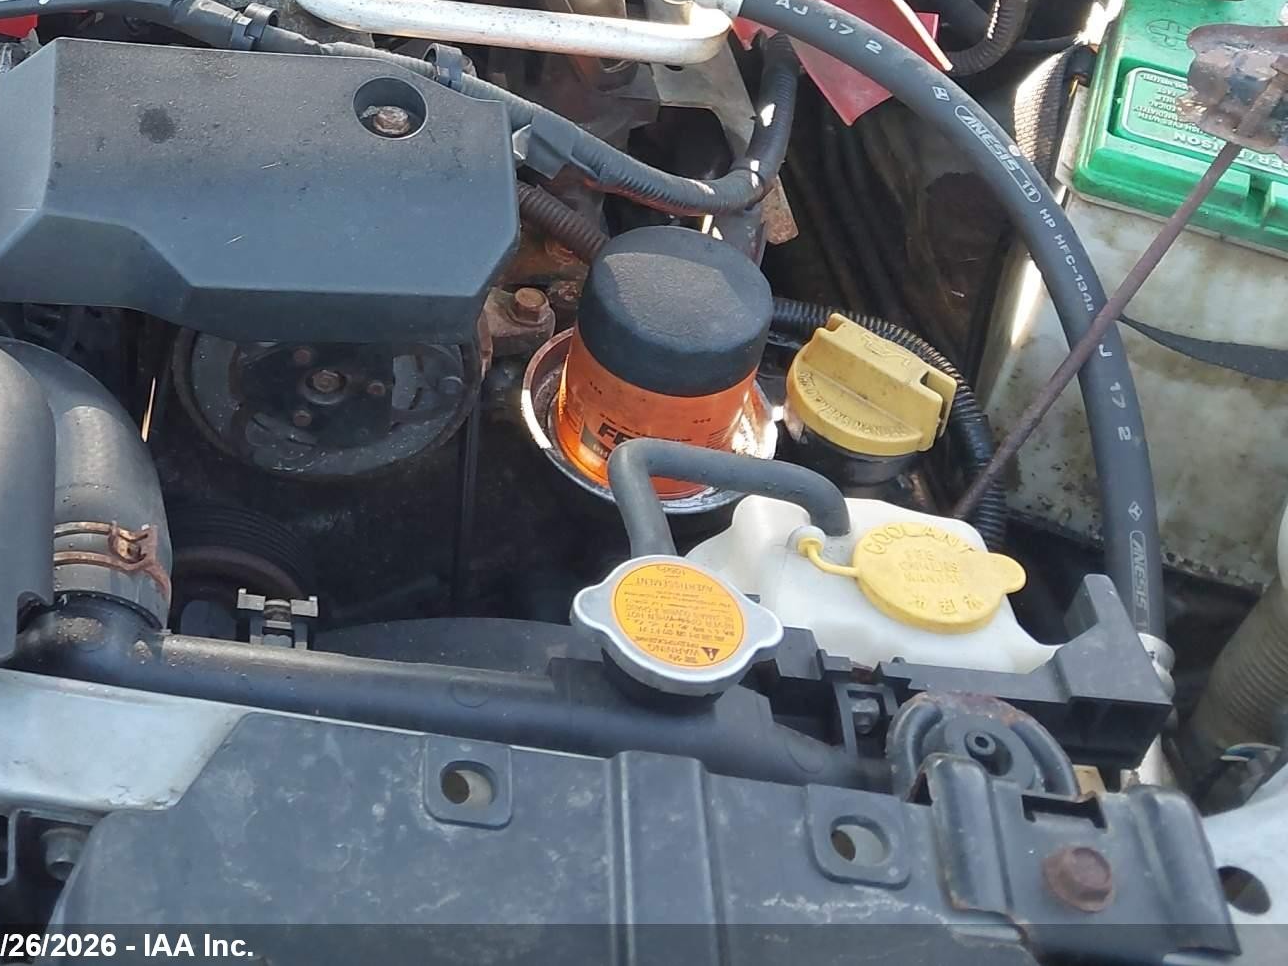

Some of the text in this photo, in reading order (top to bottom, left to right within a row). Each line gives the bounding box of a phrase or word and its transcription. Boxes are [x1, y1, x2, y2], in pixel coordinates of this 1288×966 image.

[827, 18, 854, 36] 17
[864, 39, 884, 55] 2
[1039, 208, 1094, 313] HP HFC-134a
[1110, 381, 1127, 410] 17
[1117, 425, 1132, 442] 2
[863, 524, 976, 555] COOLANT
